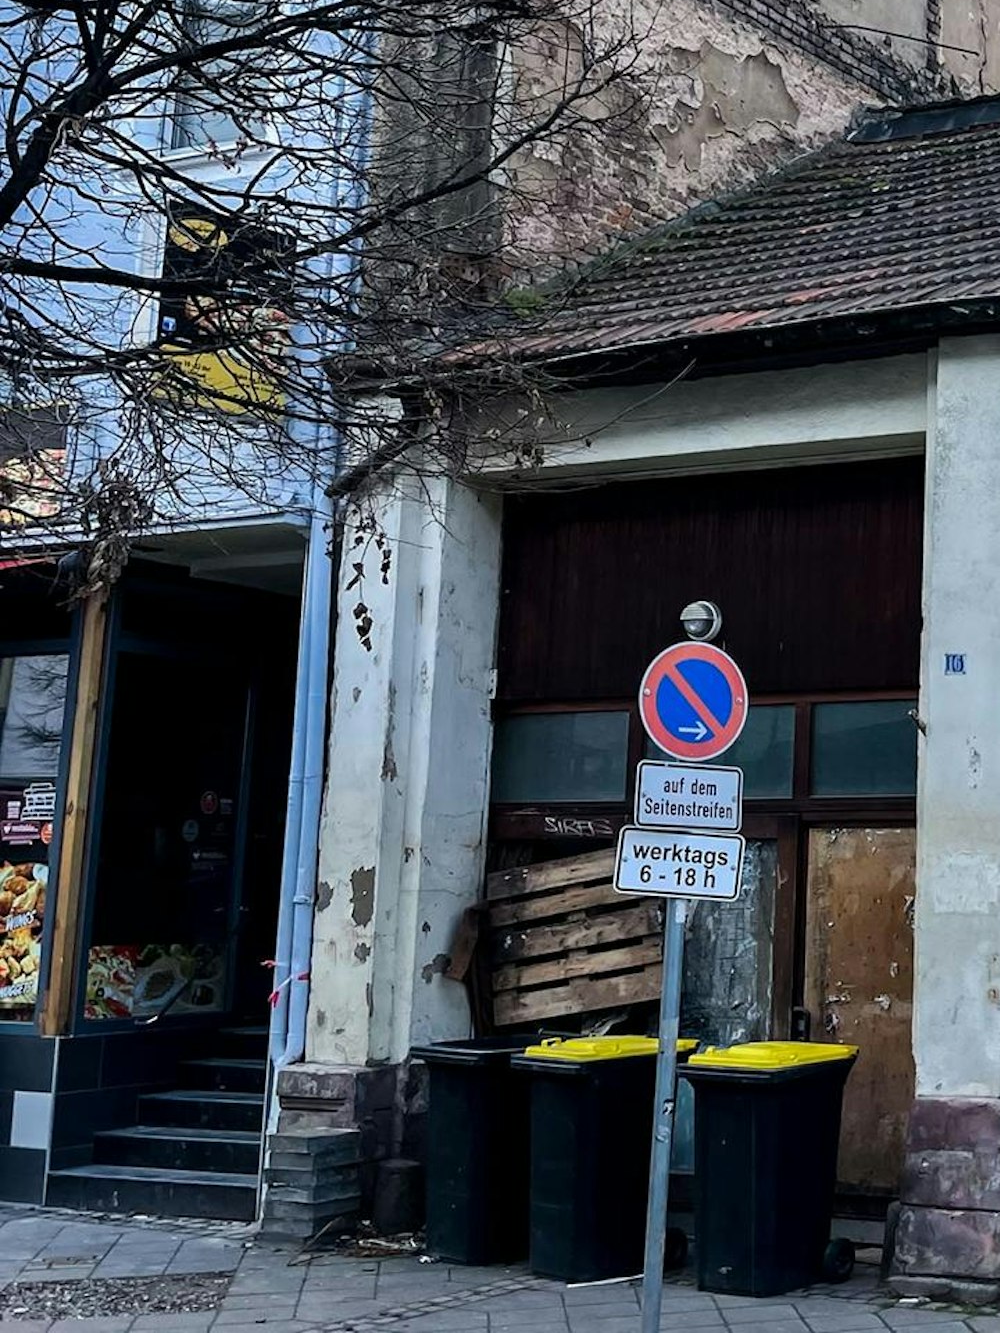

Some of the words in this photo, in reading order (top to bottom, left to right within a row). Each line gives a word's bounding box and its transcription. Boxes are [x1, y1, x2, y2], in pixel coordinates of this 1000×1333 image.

[663, 777, 685, 794] auf
[691, 778, 717, 796] dem
[644, 797, 733, 820] Seitenstreifen
[633, 843, 728, 869] werktags
[640, 864, 652, 884] 6
[674, 867, 696, 886] 18
[704, 869, 716, 889] h
